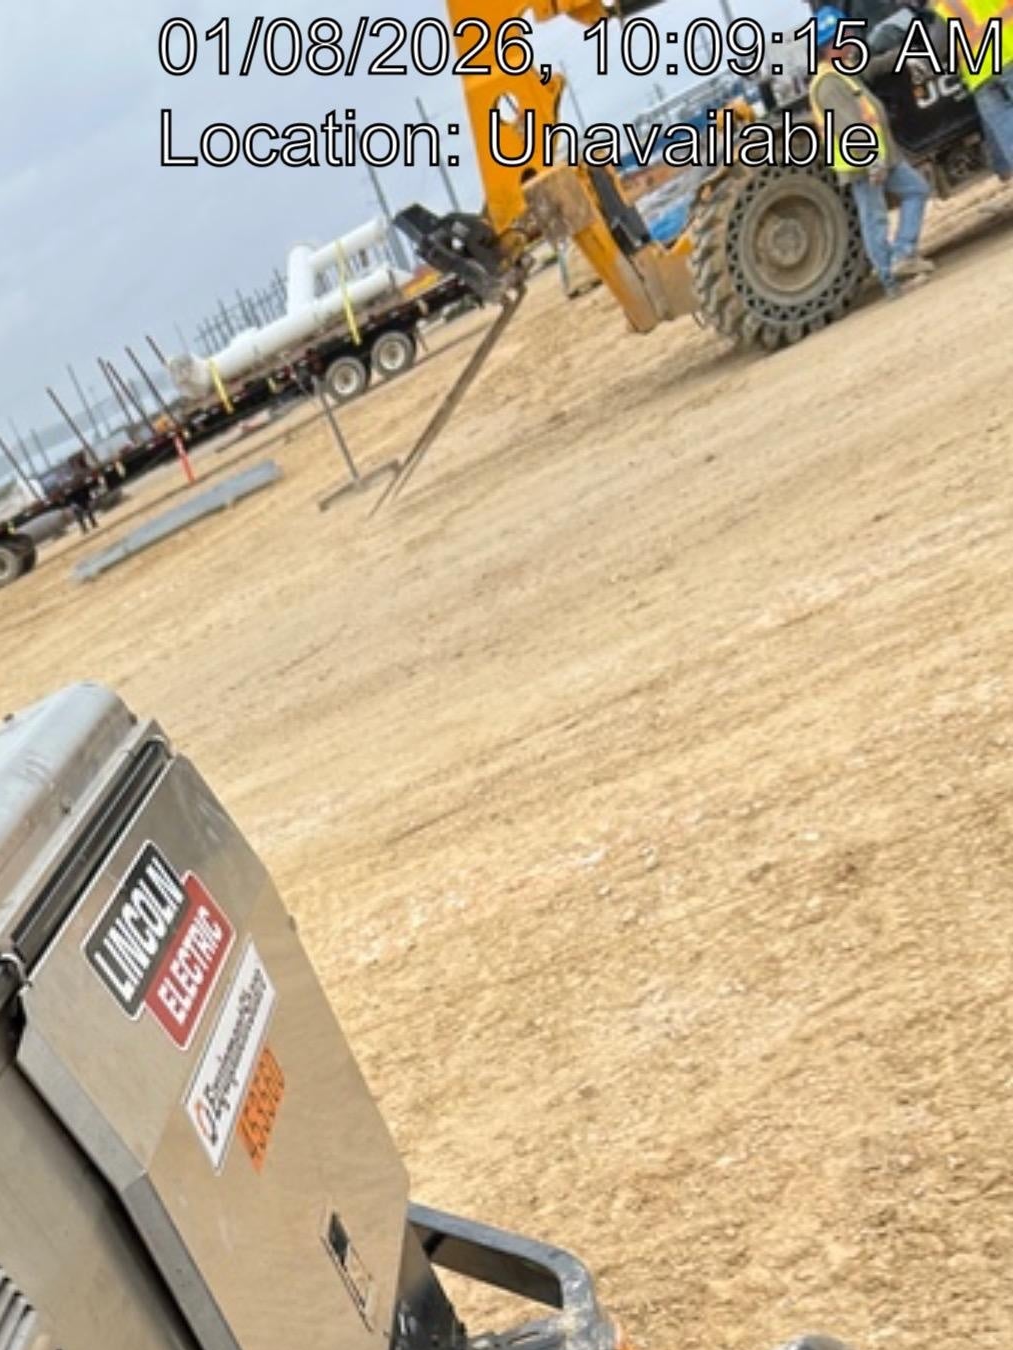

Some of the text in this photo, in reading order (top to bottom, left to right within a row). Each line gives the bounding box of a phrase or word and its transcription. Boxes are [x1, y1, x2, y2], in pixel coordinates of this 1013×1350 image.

[916, 74, 967, 109] JC
[94, 856, 185, 1002] LINCOLN
[157, 904, 223, 1026] ELECTRIC
